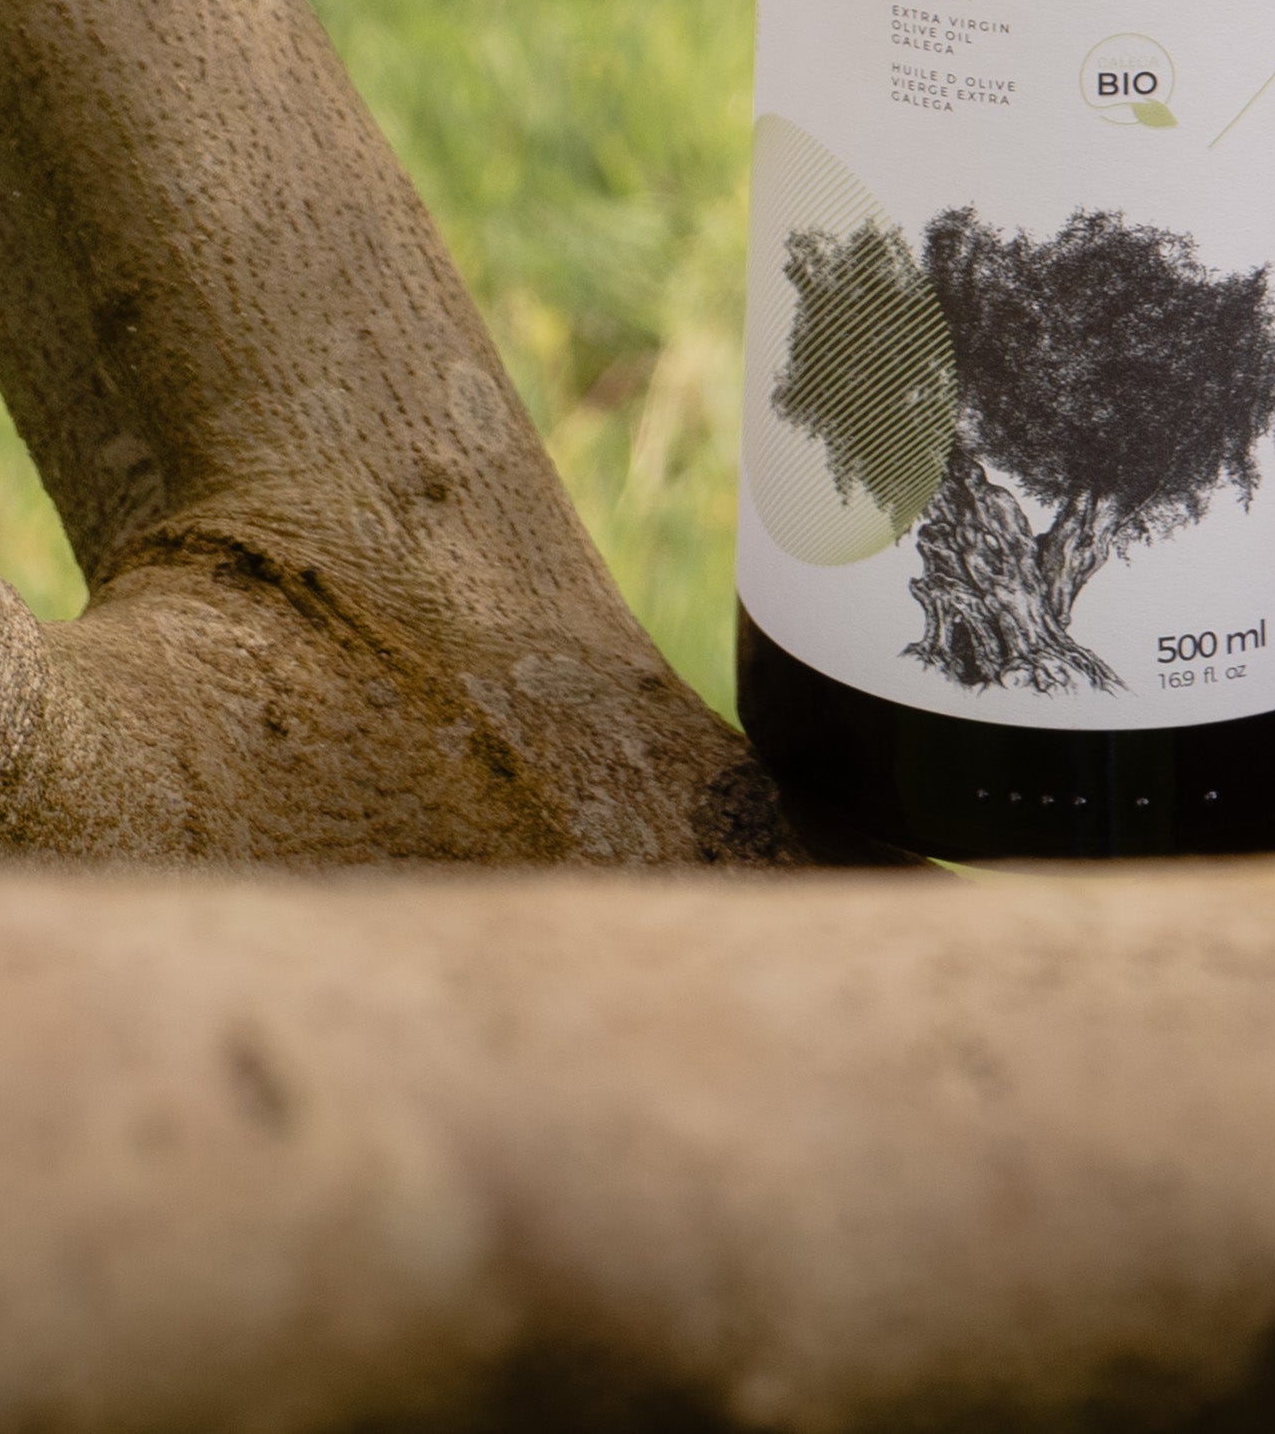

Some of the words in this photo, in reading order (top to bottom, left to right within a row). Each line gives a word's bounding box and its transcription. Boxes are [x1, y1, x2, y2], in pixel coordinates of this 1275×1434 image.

[890, 19, 937, 39] OLIVE
[944, 30, 973, 45] OIL
[892, 4, 941, 25] EXTRA
[948, 15, 1011, 34] VIRGIN
[891, 33, 955, 55] GALEGA
[891, 63, 938, 82] HUILE
[1097, 71, 1159, 97] BIO
[890, 76, 949, 98] VIERGE
[956, 89, 1011, 107] EXTRA
[890, 90, 954, 113] GALEGA
[1156, 631, 1217, 664] 500
[1226, 618, 1266, 655] ml
[1225, 664, 1247, 680] oz
